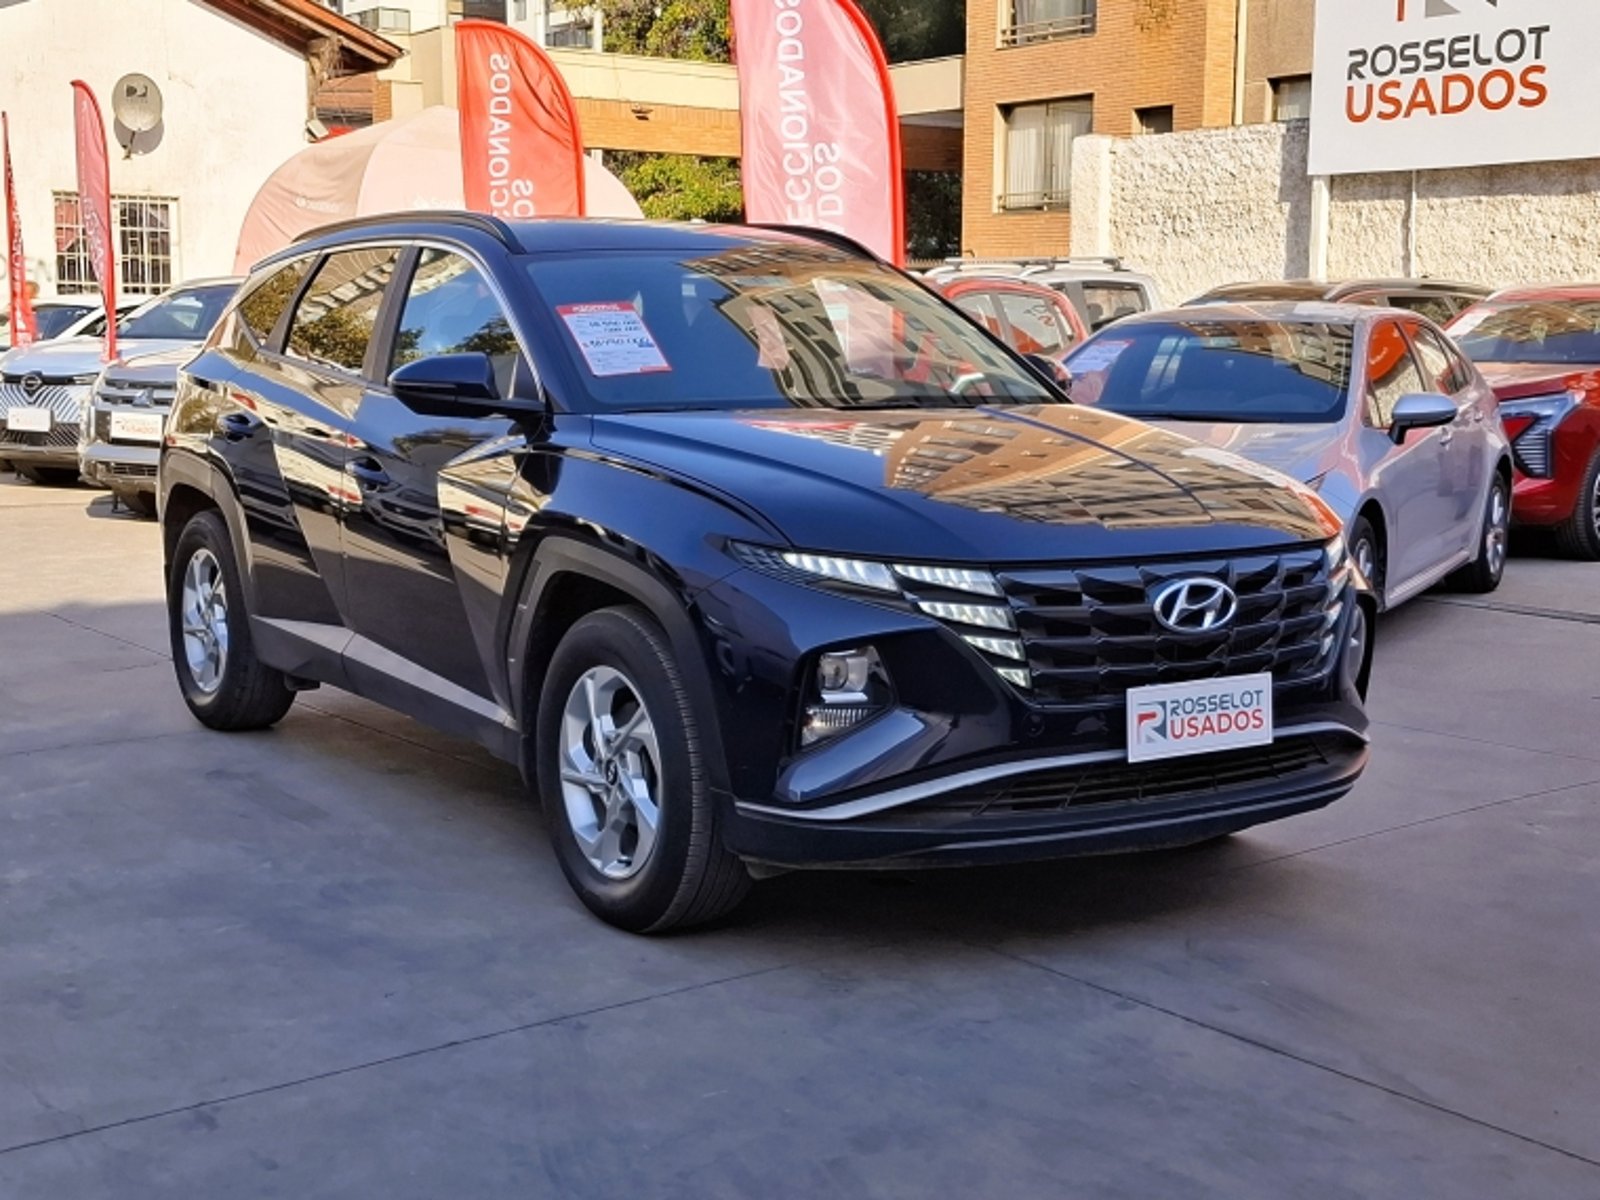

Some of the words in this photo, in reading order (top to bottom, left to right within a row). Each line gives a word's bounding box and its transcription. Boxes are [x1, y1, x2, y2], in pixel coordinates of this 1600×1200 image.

[1347, 25, 1550, 80] ROSSELOT
[1345, 65, 1548, 122] USADOS
[1170, 690, 1263, 716] ROSSELOT
[1170, 709, 1264, 739] USADOS
